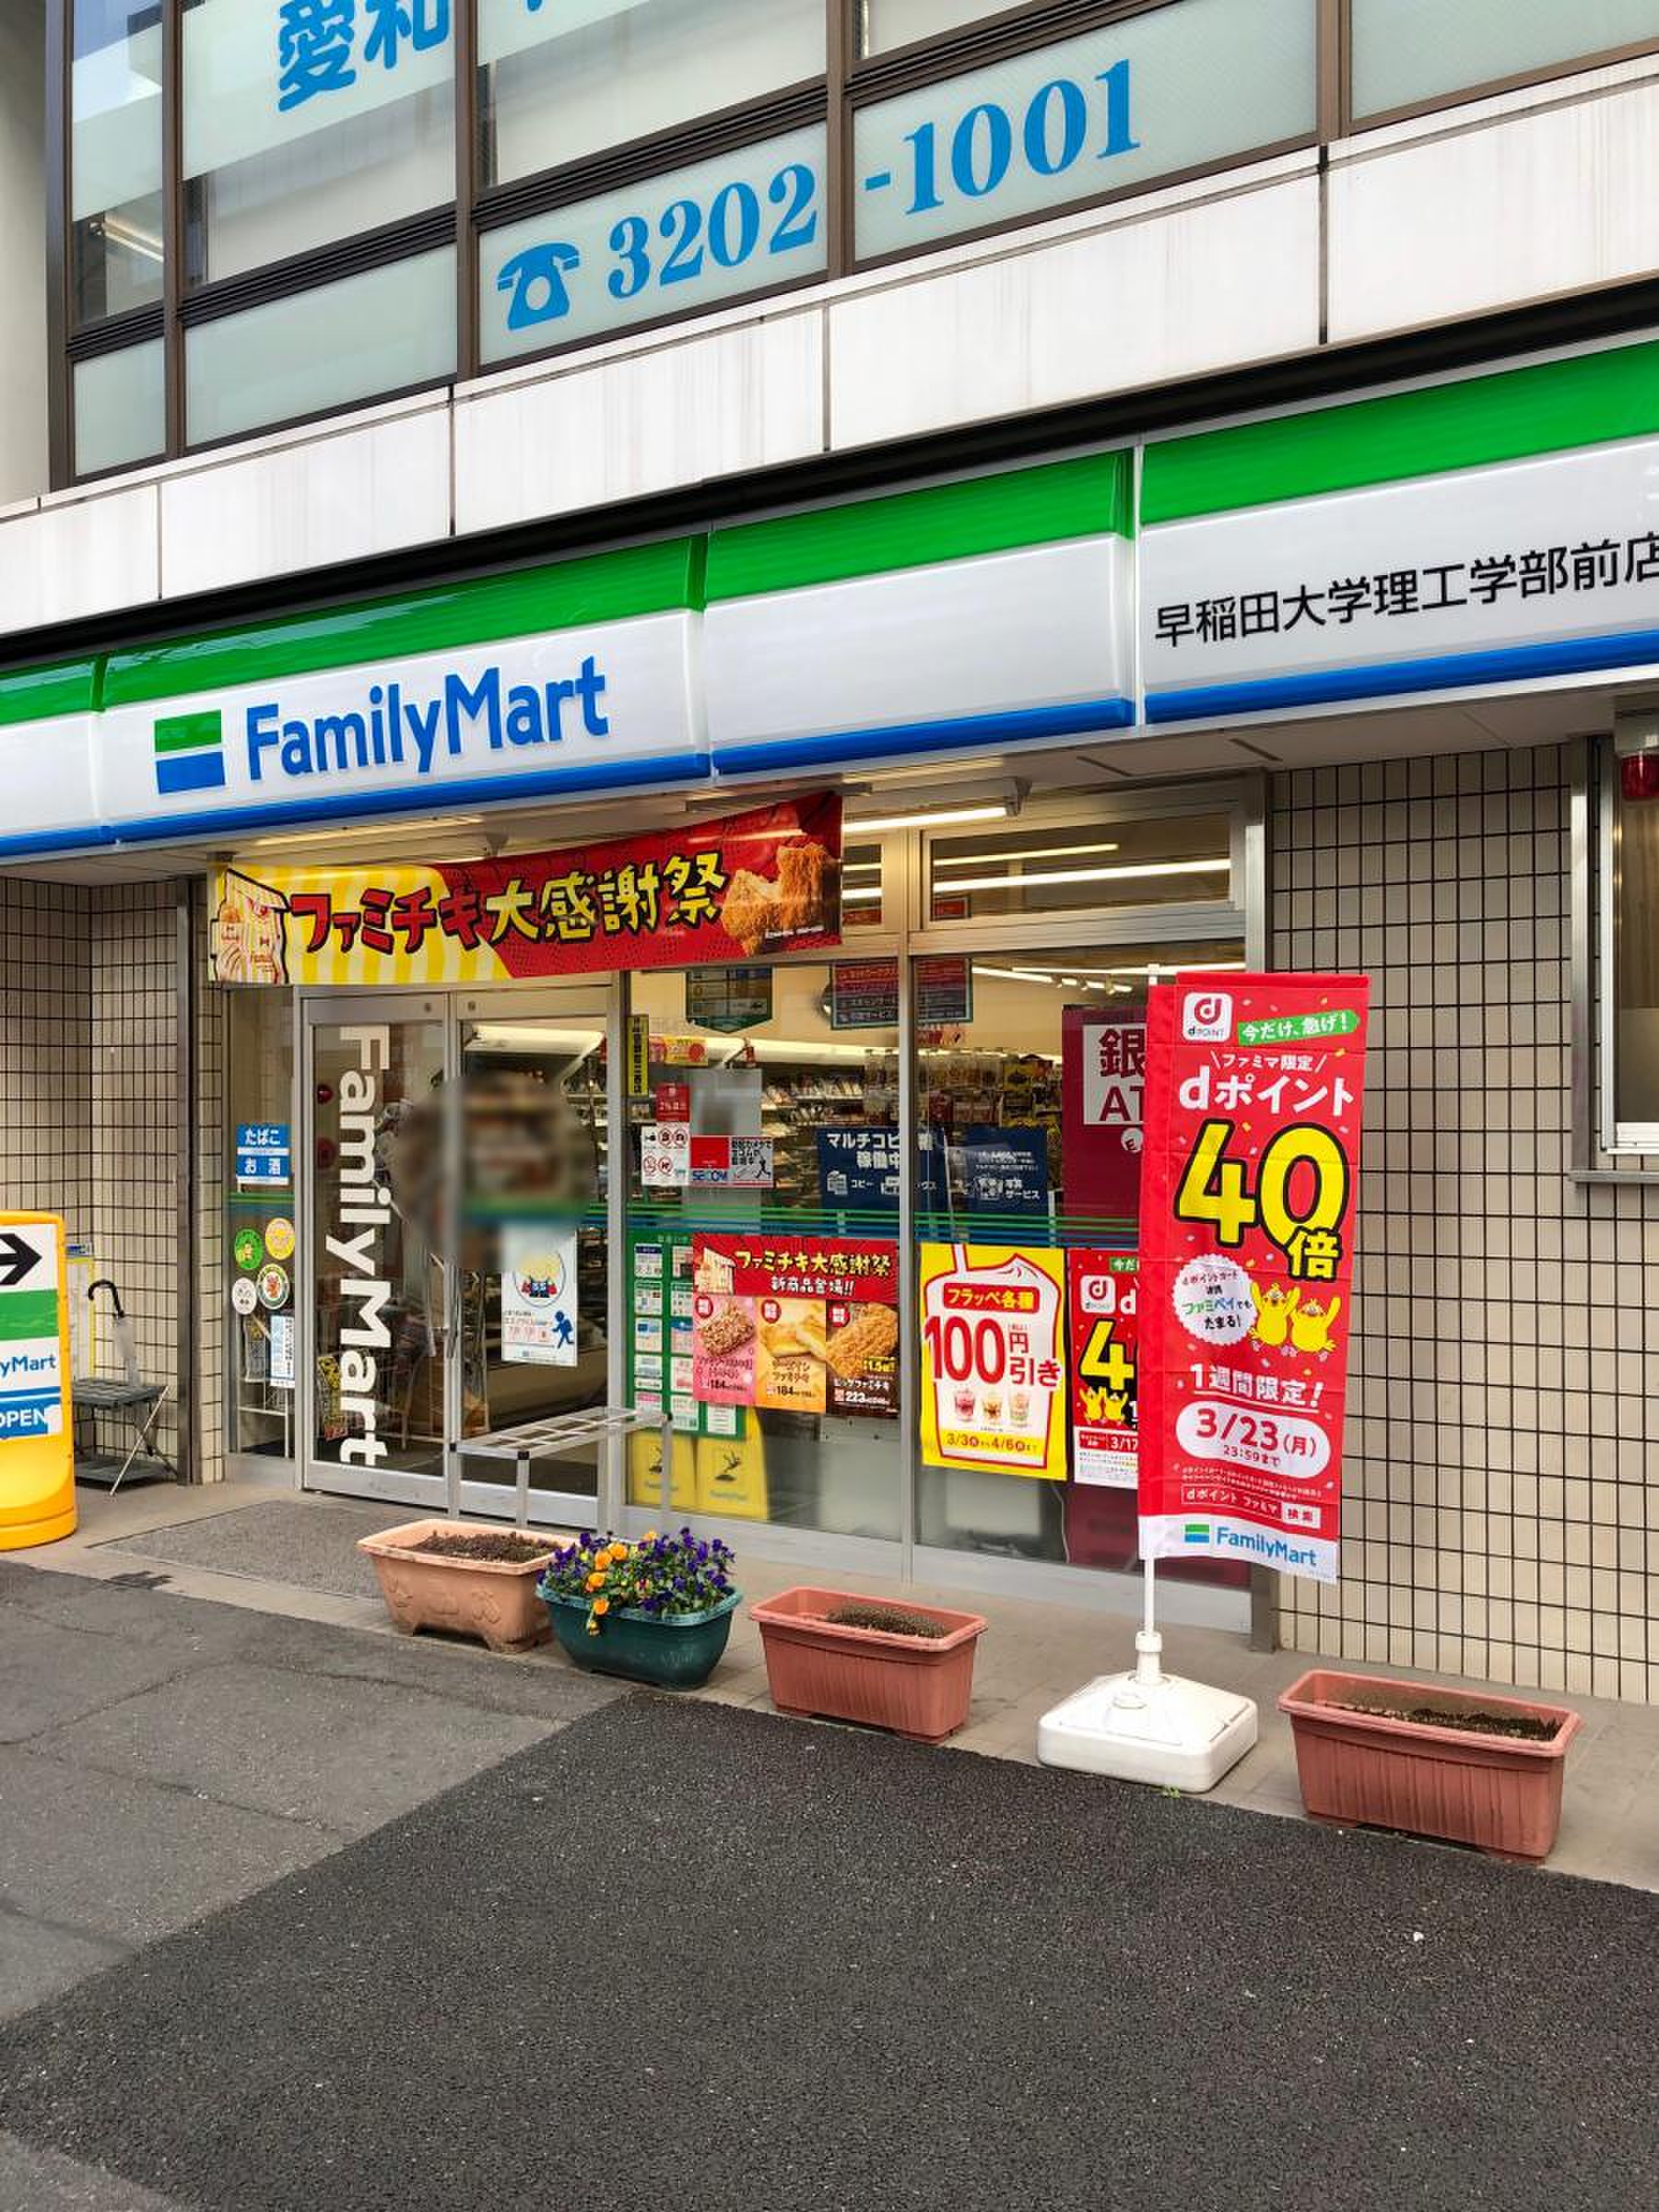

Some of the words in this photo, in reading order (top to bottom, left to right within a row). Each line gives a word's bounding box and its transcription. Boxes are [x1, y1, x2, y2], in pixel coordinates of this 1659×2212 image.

[607, 163, 817, 300] 3202
[1155, 530, 1659, 647] 早稲田大学理工学部前店
[246, 655, 609, 781] FamilyMart
[287, 849, 730, 953] ファミチキ大感謝祭
[1099, 1028, 1145, 1079] 銀
[1222, 1054, 1313, 1072] ファミマ限定
[1100, 1086, 1144, 1121] AT
[1179, 1065, 1354, 1116] dポイント
[244, 1128, 281, 1146] たばこ
[827, 1133, 934, 1151] マルチコピ機
[325, 1025, 391, 1466] FamilyMart
[735, 1250, 891, 1277] ファミチキ大感謝祭
[0, 1355, 56, 1377] yMart
[924, 1315, 1006, 1384] 100
[1190, 1364, 1323, 1406] 1週間限定!
[1217, 1526, 1317, 1567] FamilyMart
